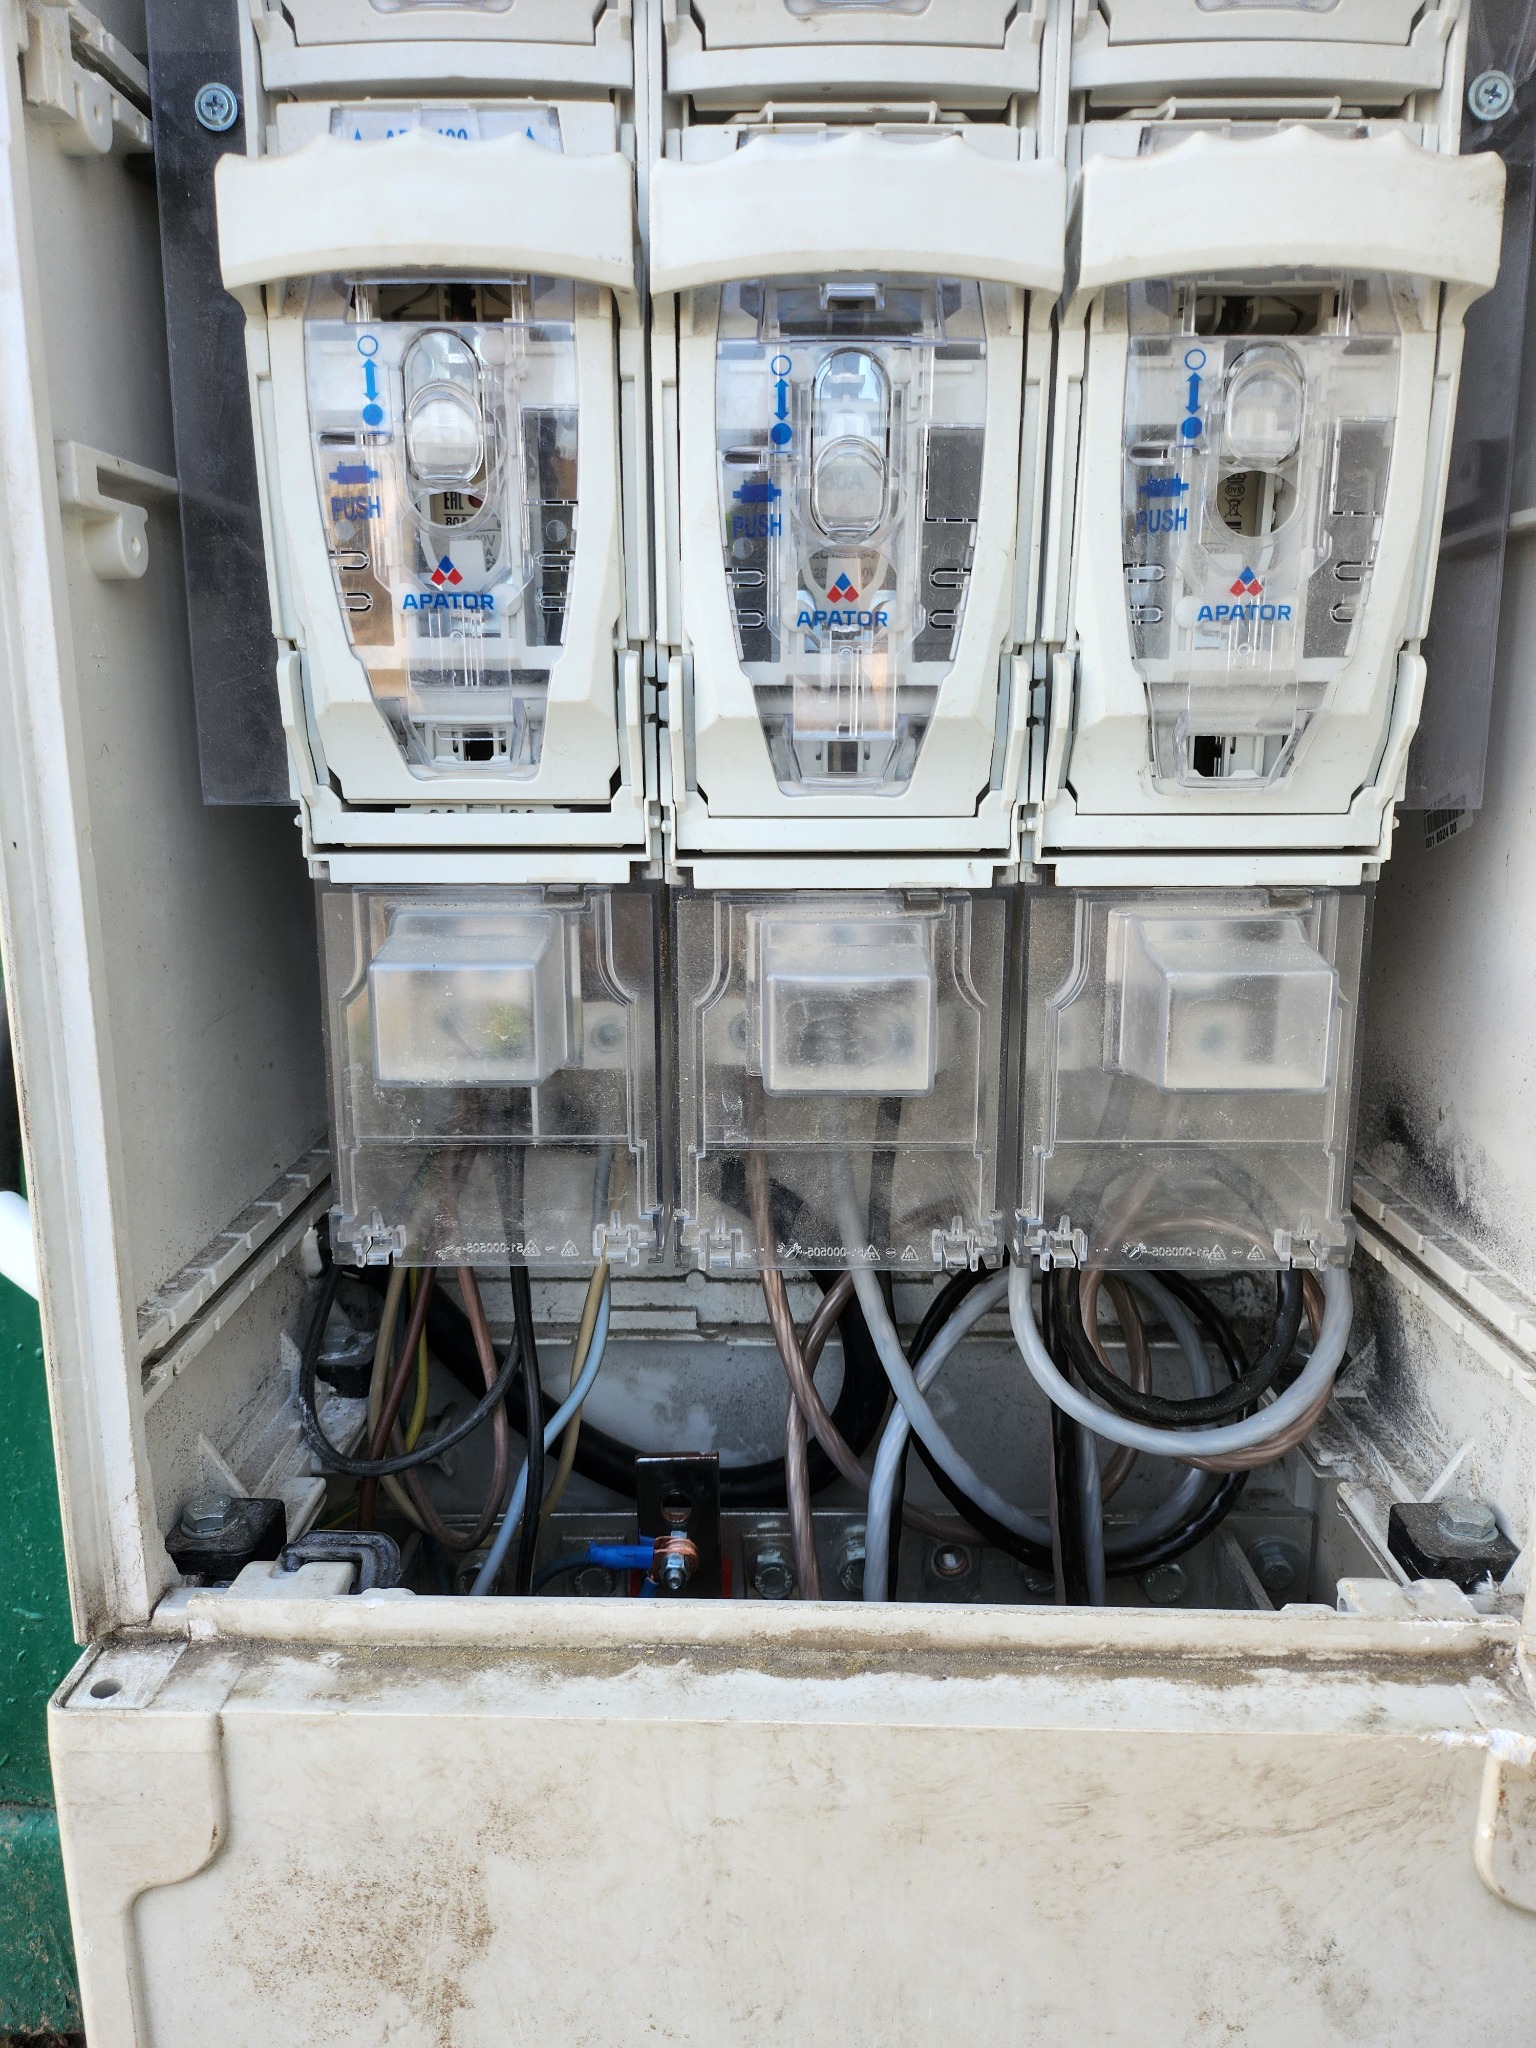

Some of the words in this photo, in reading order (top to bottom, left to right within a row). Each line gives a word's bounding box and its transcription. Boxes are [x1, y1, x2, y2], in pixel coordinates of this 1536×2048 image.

[330, 496, 381, 521] PUSH
[733, 514, 782, 538] PUSH
[1136, 508, 1188, 534] PUSH
[402, 594, 495, 610] APATOR
[796, 610, 888, 627] APATOR
[1197, 604, 1291, 622] APATOR
